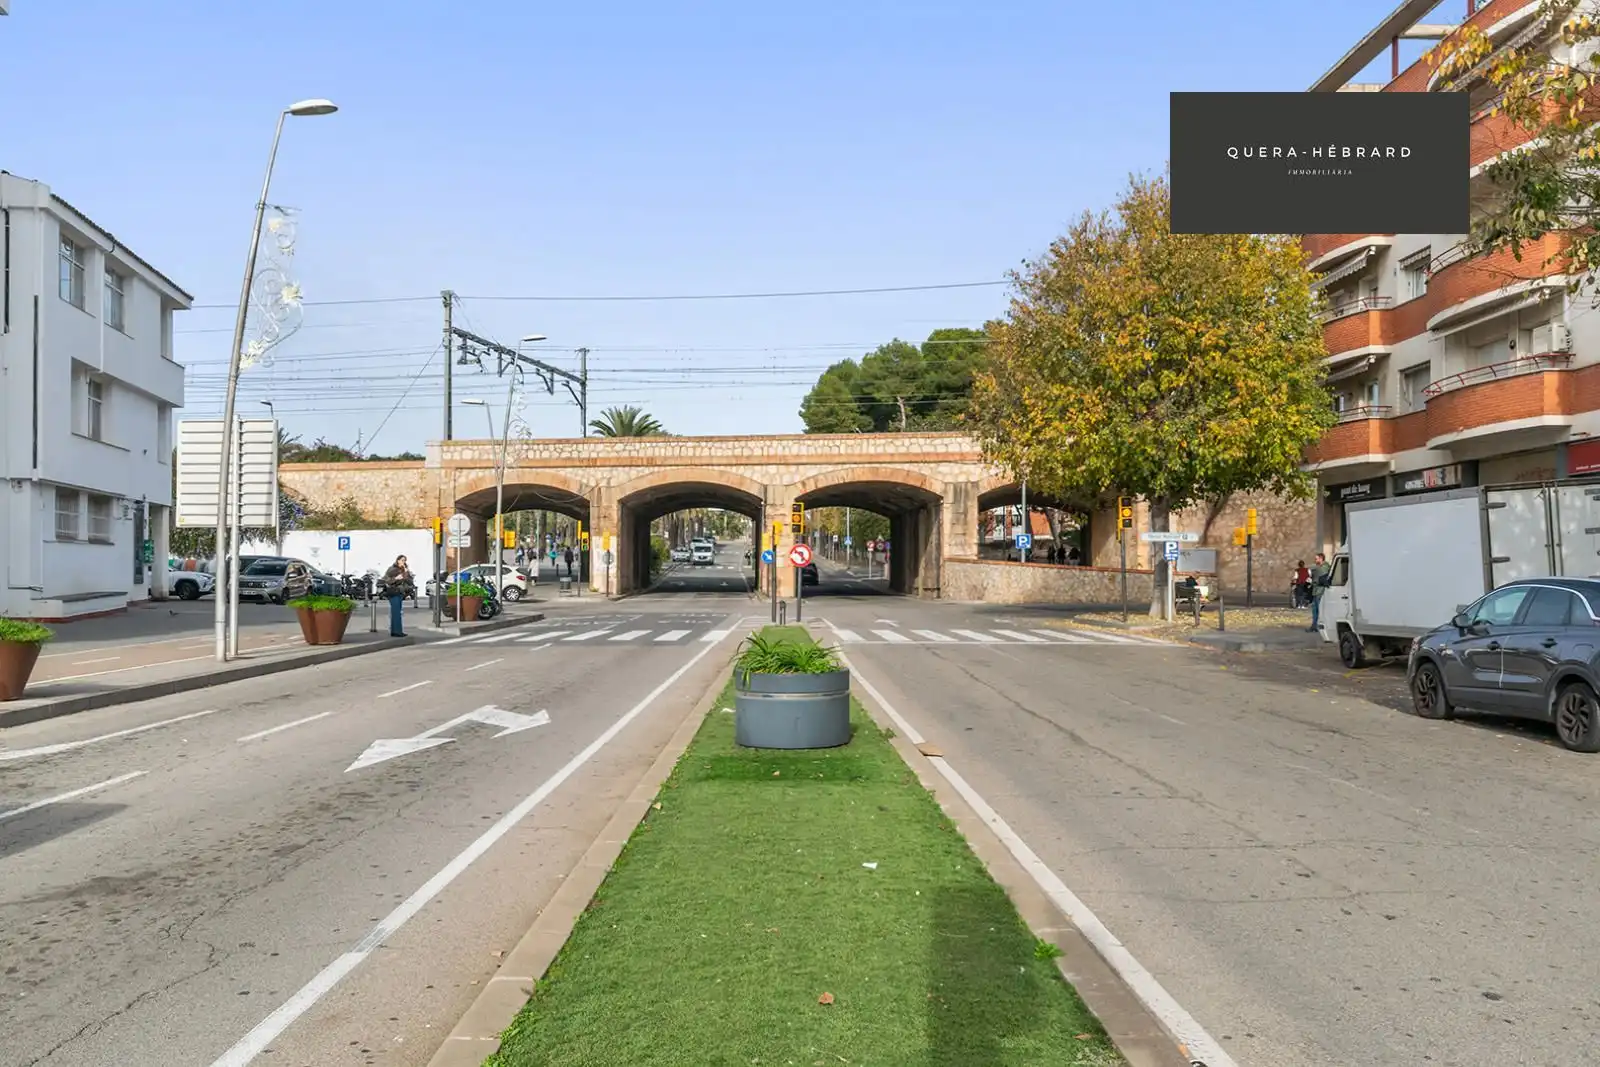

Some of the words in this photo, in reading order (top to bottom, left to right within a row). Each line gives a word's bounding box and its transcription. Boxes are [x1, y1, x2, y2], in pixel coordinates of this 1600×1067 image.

[340, 538, 348, 548] P
[1019, 536, 1028, 547] P
[1166, 542, 1177, 553] P
